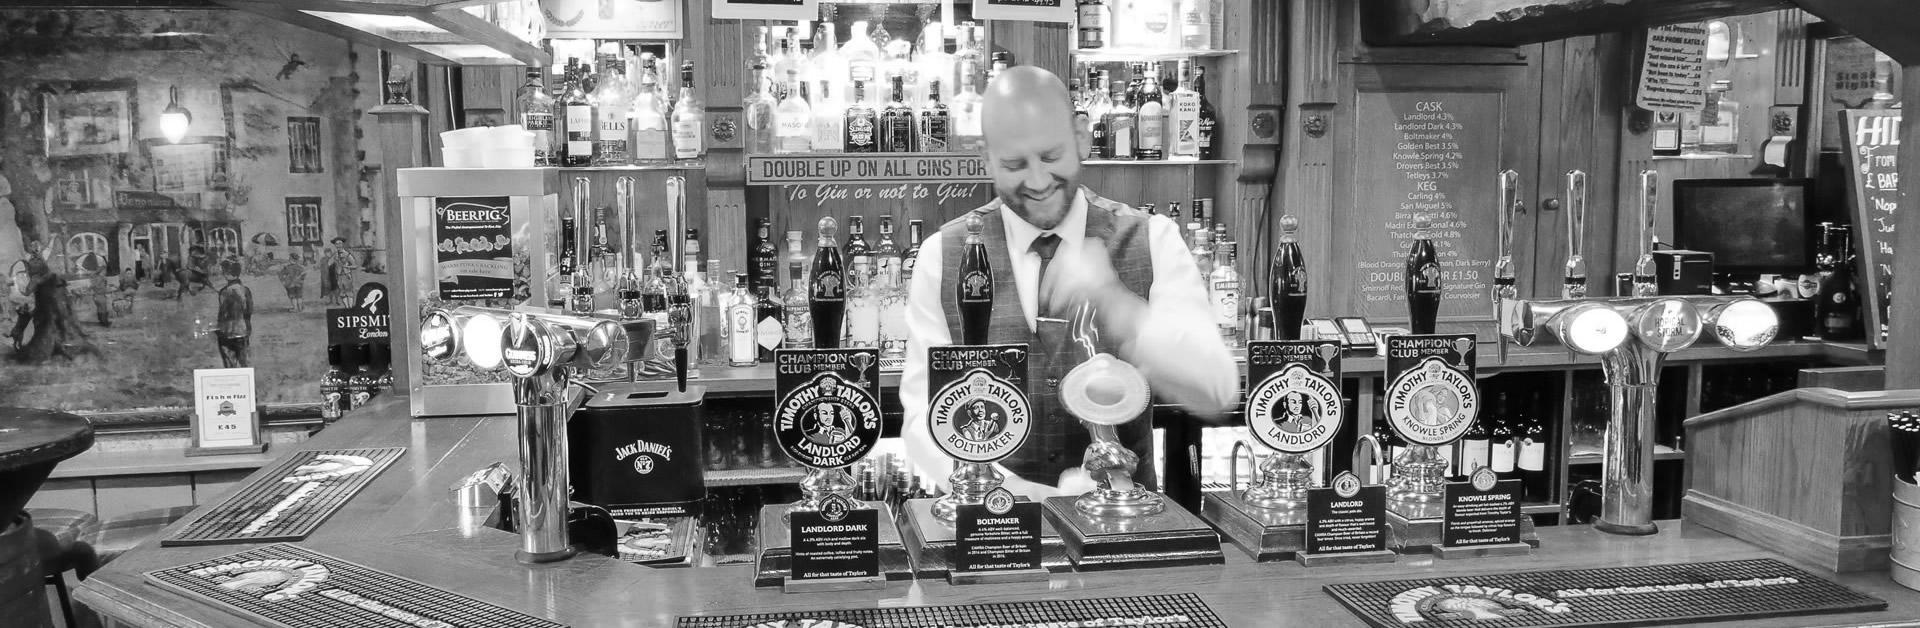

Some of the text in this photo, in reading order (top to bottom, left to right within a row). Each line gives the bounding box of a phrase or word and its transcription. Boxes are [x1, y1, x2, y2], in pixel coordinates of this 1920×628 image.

[1416, 102, 1442, 111] CASK
[1393, 152, 1420, 160] Knowle
[1421, 153, 1444, 161] Spring
[1860, 145, 1896, 174] From
[763, 159, 987, 177] DOUBLE UP ON ALL GINS FOR
[1406, 172, 1430, 180] Tetleys
[1417, 182, 1437, 191] KEG
[784, 183, 978, 206] To Gin or not to Gin!
[1408, 193, 1433, 201] Carling
[1416, 203, 1439, 211] Miguel
[447, 209, 502, 221] BEERPIG
[1358, 261, 1379, 269] (Blood
[1370, 271, 1478, 282] DOUBL £1.50
[1443, 283, 1473, 291] Signature
[337, 315, 390, 328] SIPSMI
[358, 328, 389, 339] London
[1251, 344, 1315, 355] CHAMPION
[1390, 339, 1452, 349] CHAMPION
[779, 353, 848, 364] CHAMPION
[931, 349, 999, 361] CHAMPION
[1390, 349, 1419, 358] CLUB
[931, 359, 997, 371] CLUB MEMBER
[1251, 354, 1282, 365] CLUB
[779, 363, 846, 374] CLUB MEMBER
[1394, 370, 1473, 411] TIMOTHY TAYLOR'S
[1256, 377, 1338, 418] TIMOTHY TAYLOR'S
[780, 385, 879, 432] TIMOTHY TAYLOR'S
[936, 384, 1025, 426] TIMOTHY TAYLOR'S
[1402, 412, 1466, 437] KNOWLE SPRING
[1267, 424, 1326, 445] LANDLORD
[797, 435, 861, 457] LANDLORD
[947, 431, 1015, 454] BOLTMAKER
[615, 439, 673, 462] JACK DANIEL'S
[812, 455, 845, 466] DARK
[1330, 500, 1364, 508] LANDLORD
[976, 517, 1020, 525] BOLTMAKER
[801, 524, 868, 533] LANDLORD DARK
[1557, 576, 1799, 598] All for that taste of Taylor's
